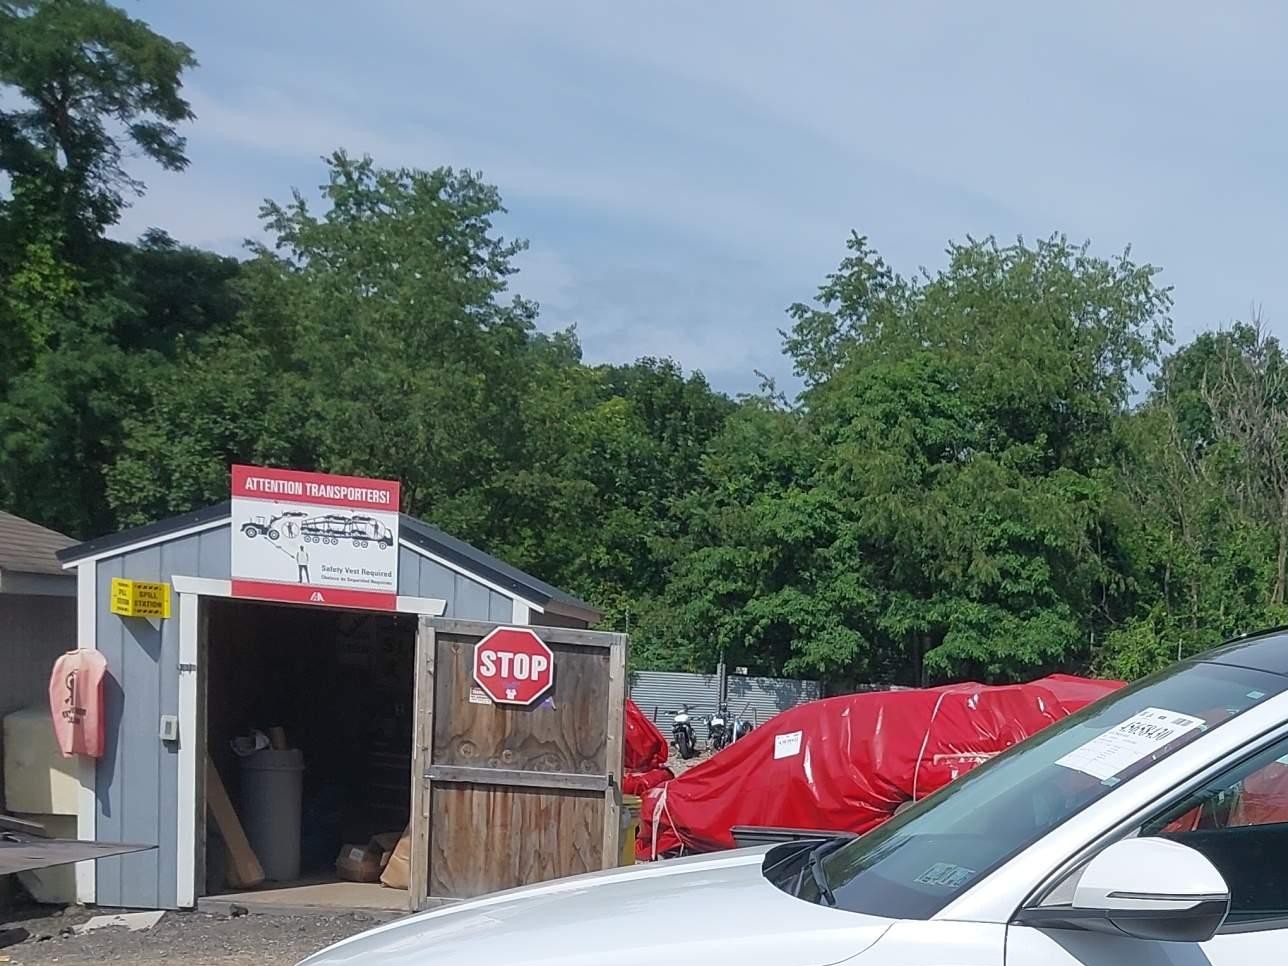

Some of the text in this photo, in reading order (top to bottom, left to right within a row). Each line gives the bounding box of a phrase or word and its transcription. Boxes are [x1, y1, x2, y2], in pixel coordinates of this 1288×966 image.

[245, 477, 390, 504] ATTENTION TRANSPORTERS!
[321, 565, 392, 578] Safety Vest Required
[139, 591, 158, 599] SPILL
[479, 650, 548, 681] STOP
